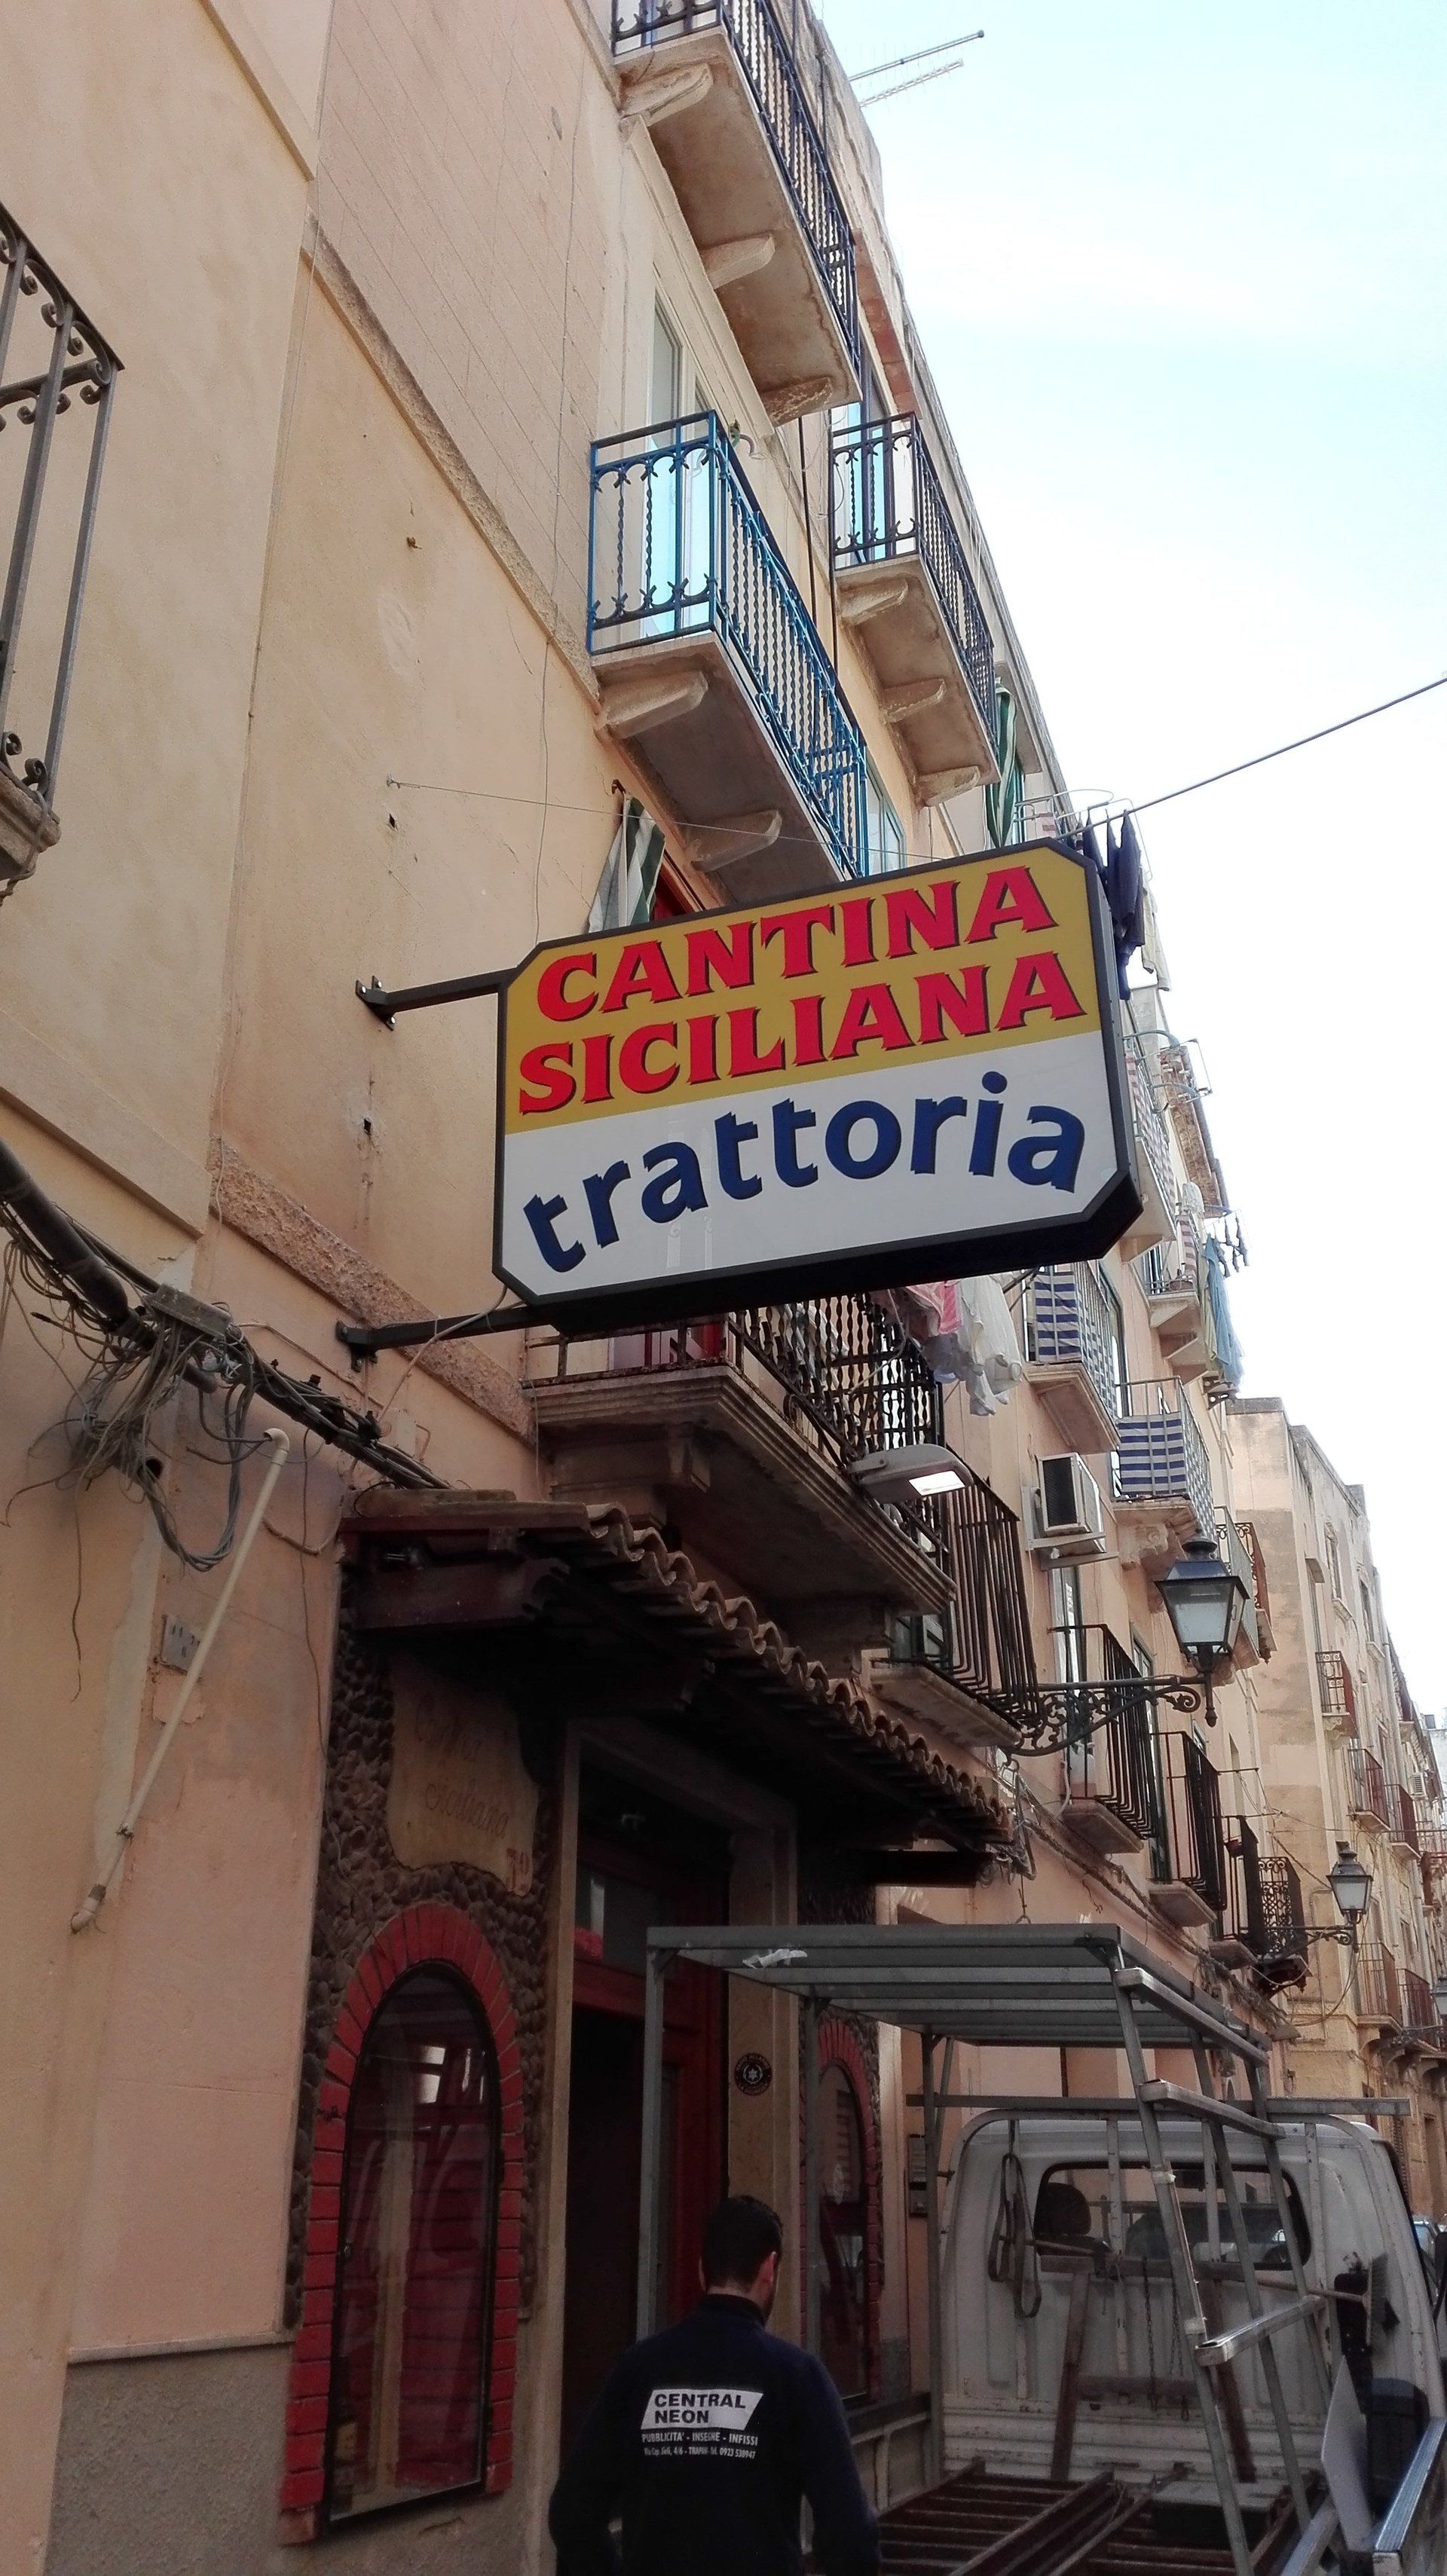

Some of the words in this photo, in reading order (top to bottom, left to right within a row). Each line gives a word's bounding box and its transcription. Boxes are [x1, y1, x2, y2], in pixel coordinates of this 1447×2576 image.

[537, 866, 1058, 1022] CANTINA
[519, 951, 1087, 1115] SICILIANA
[523, 1071, 1085, 1273] trattoria
[654, 2393, 746, 2409] CENTRAL
[654, 2409, 709, 2424] NEON
[642, 2432, 684, 2443] PUBBLICITA'
[692, 2432, 720, 2442] INSEGNE
[729, 2434, 758, 2446] INFISSI
[720, 2447, 734, 2457] 0923
